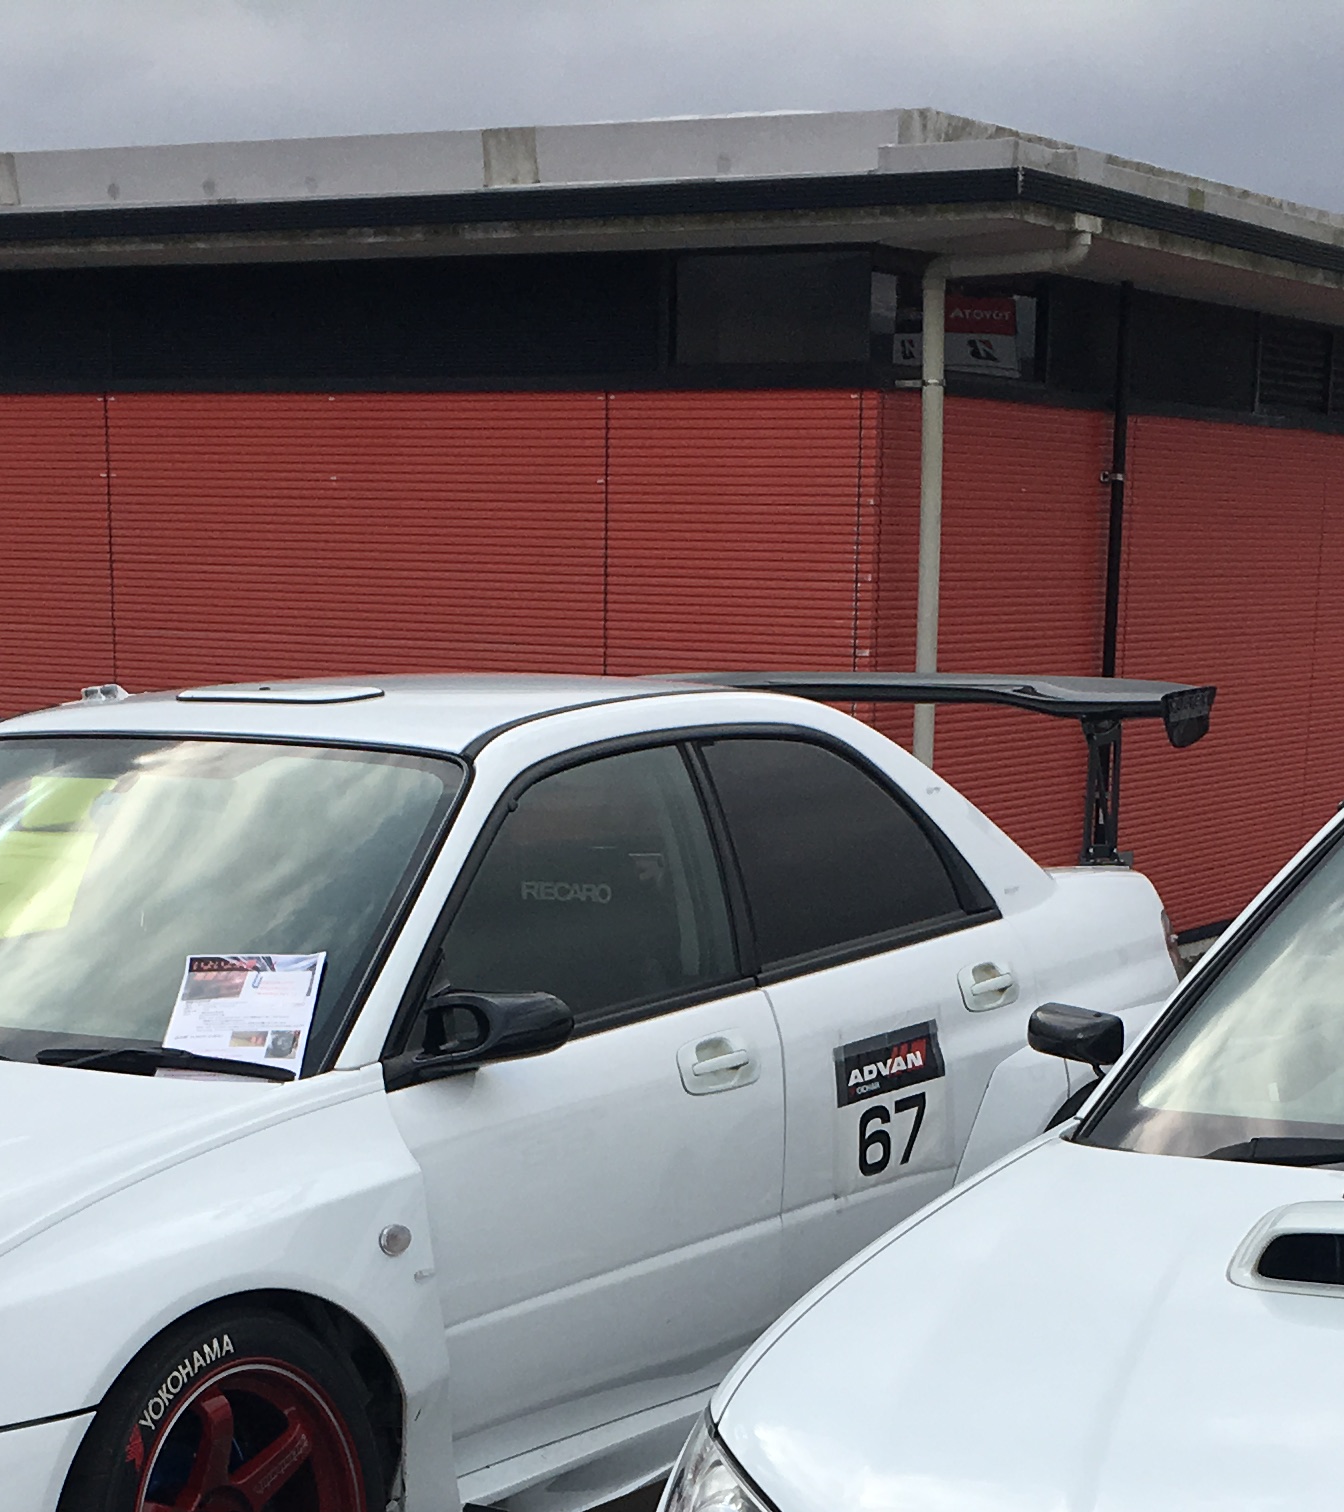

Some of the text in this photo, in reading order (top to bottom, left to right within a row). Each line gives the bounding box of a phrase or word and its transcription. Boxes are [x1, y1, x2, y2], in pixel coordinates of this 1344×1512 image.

[521, 881, 613, 904] RECARO
[848, 1051, 924, 1087] ADVAN
[859, 1091, 926, 1177] 67
[139, 1334, 235, 1431] YOKOHAMA
